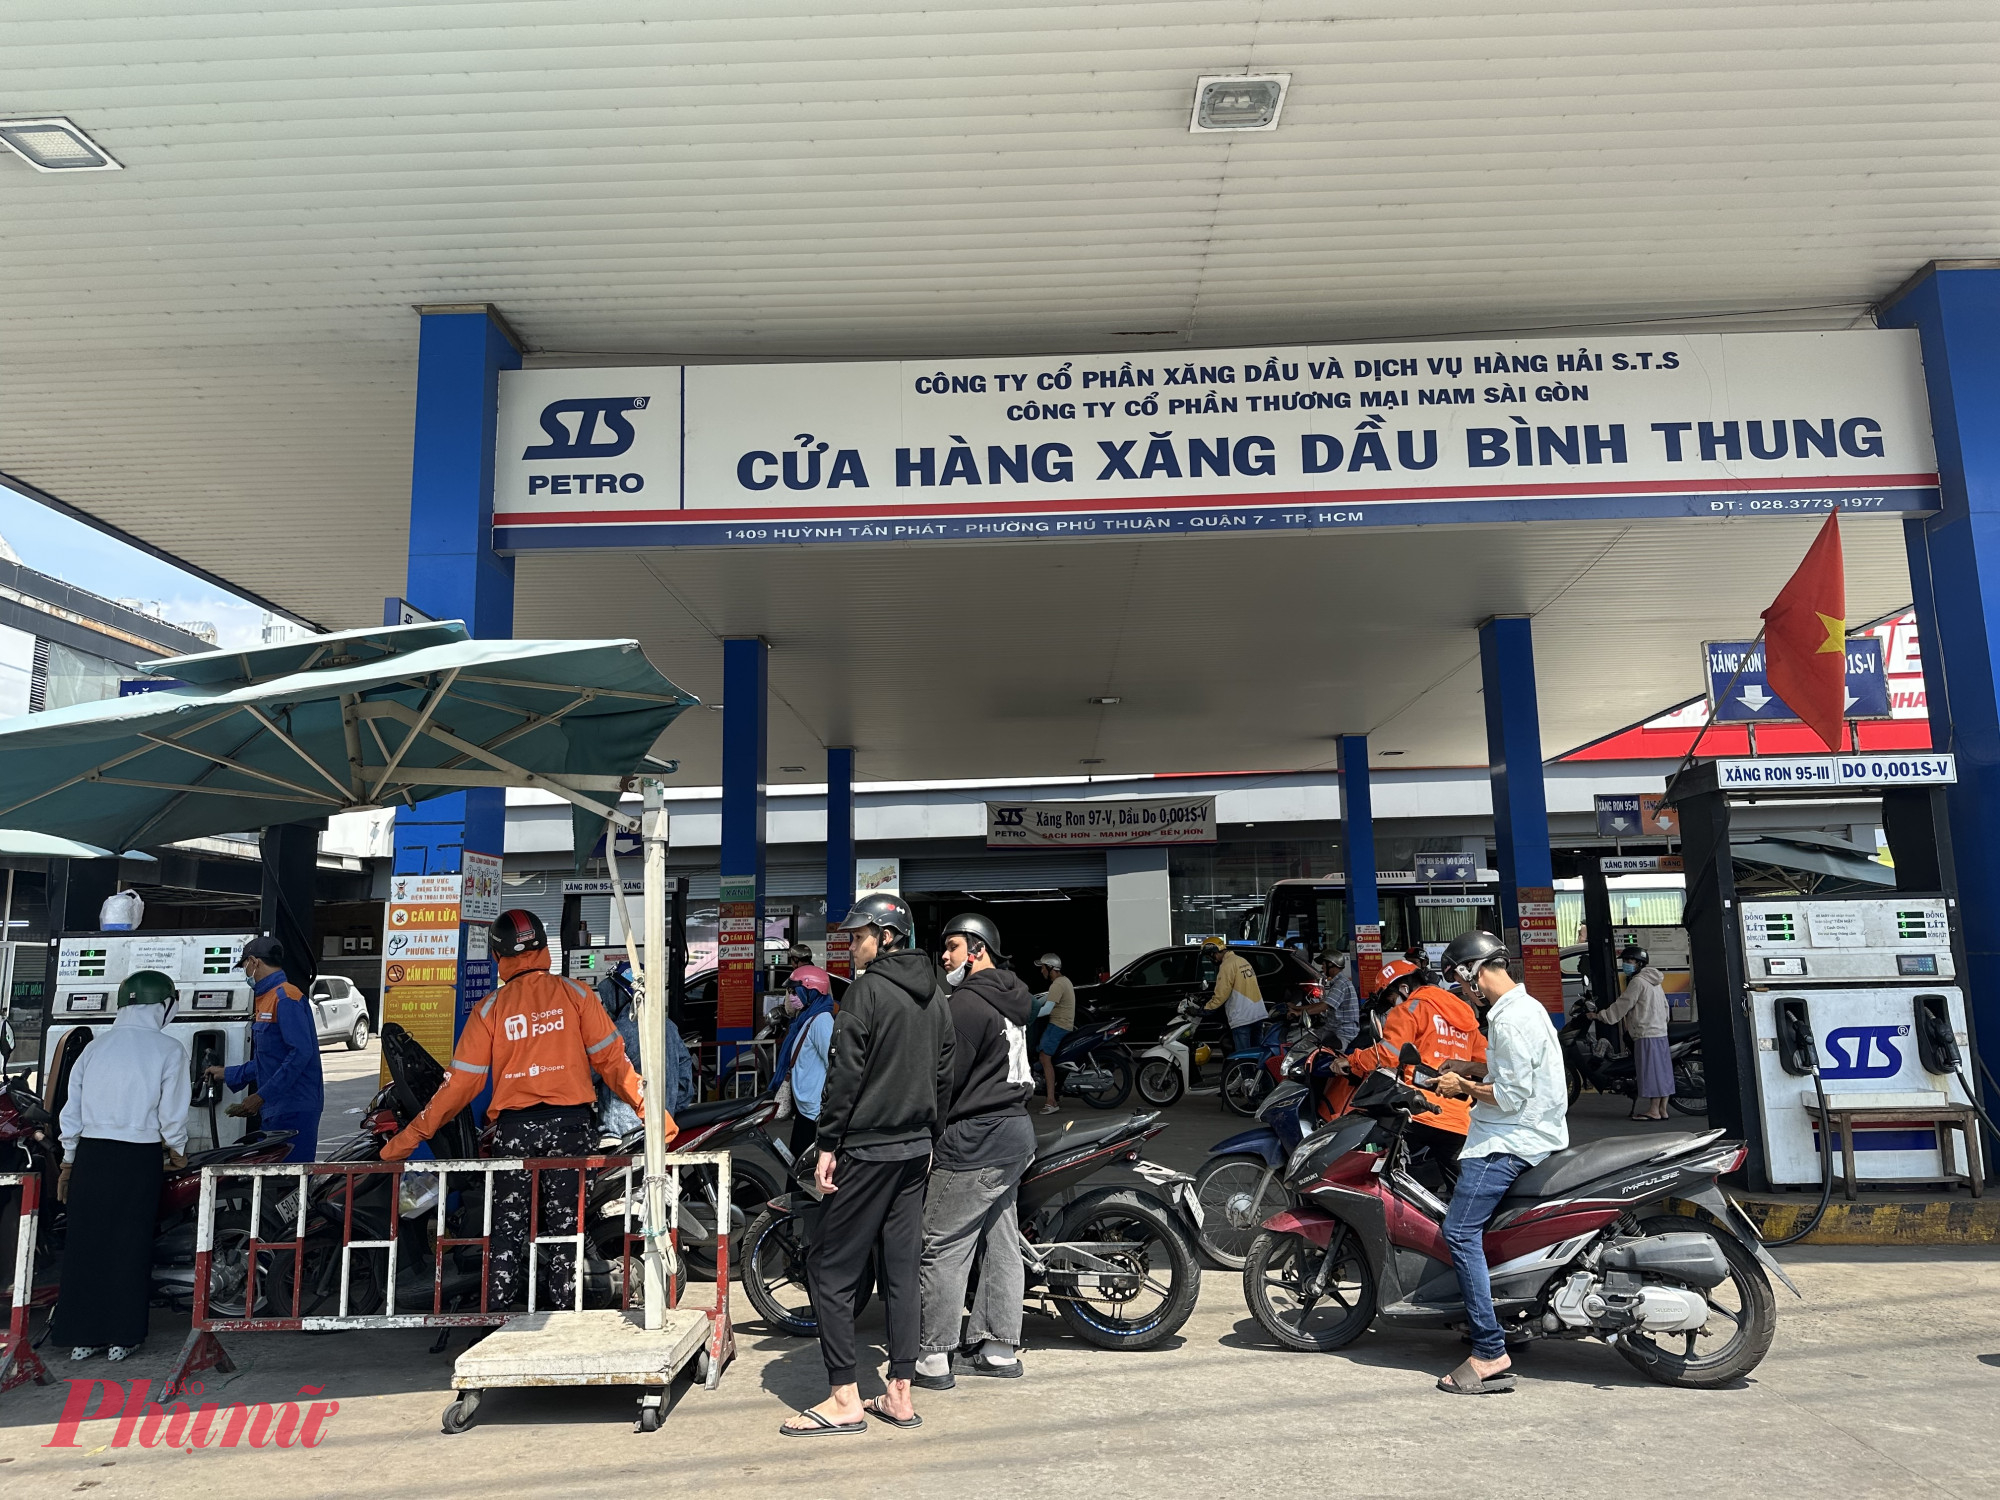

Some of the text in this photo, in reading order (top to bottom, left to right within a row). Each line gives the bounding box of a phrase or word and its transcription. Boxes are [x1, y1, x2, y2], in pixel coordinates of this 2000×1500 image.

[914, 347, 1680, 394] CÔNG TY CỔ PHẦN XĂNG DẦU VÀ DỊCH VỤ HÀNG HẢI S.T.S
[1006, 380, 1589, 421] CÔNG TY CỔ PHẦN THƯƠNG MẠI NAM SÀI GÒN
[736, 412, 1885, 491] CỬA HÀNG XĂNG DẦU BÌNH THUNG
[528, 472, 645, 496] PETRO
[1710, 501, 1743, 511] ĐT:
[725, 529, 767, 539] 1409
[773, 525, 842, 538] HUỲNH
[848, 522, 888, 536] TẤN
[894, 522, 947, 535] PHÁT
[965, 520, 1049, 533] PHƯỜNG
[1056, 517, 1096, 531] PHÚ
[1102, 515, 1171, 530] THUẬN
[1189, 513, 1246, 527] QUẬN
[1253, 514, 1264, 524] 7
[1281, 513, 1312, 523] TP.
[1318, 511, 1364, 522] HCM
[1710, 650, 1739, 674] XĂNG
[1725, 759, 1831, 782] XĂNG RON 95-III
[1842, 761, 1949, 781] DO 0,001S-V
[1597, 800, 1612, 812] XĂNG
[1613, 801, 1625, 812] RON
[1036, 811, 1063, 829] Xăng
[1066, 810, 1087, 826] Ron
[1089, 808, 1116, 828] 97-V,
[1119, 807, 1140, 825] Dầu
[1142, 807, 1157, 824] Do
[1070, 831, 1091, 839] HƠN
[1131, 829, 1152, 838] HƠN
[1183, 827, 1204, 836] HƠN
[1604, 860, 1623, 869] XĂNG
[1624, 860, 1638, 869] RON
[565, 882, 599, 891] XĂNG RON
[623, 881, 642, 890] XĂNG
[411, 908, 435, 922] CẤM
[1744, 912, 1764, 921] ĐỒNG
[1925, 910, 1945, 919] ĐỒNG
[1746, 923, 1765, 931] LÍT
[1926, 920, 1946, 929] LÍT
[61, 948, 80, 957] ĐỒNG
[60, 959, 79, 968] LÍT
[406, 965, 421, 981] CẤM
[401, 1001, 439, 1011] NỘI QUY
[531, 1008, 564, 1022] Shopee
[532, 1016, 565, 1038] Food
[540, 1064, 565, 1073] Shopee
[1298, 1172, 1319, 1186] SUZUKI
[1621, 1170, 1681, 1195] IMPULSE
